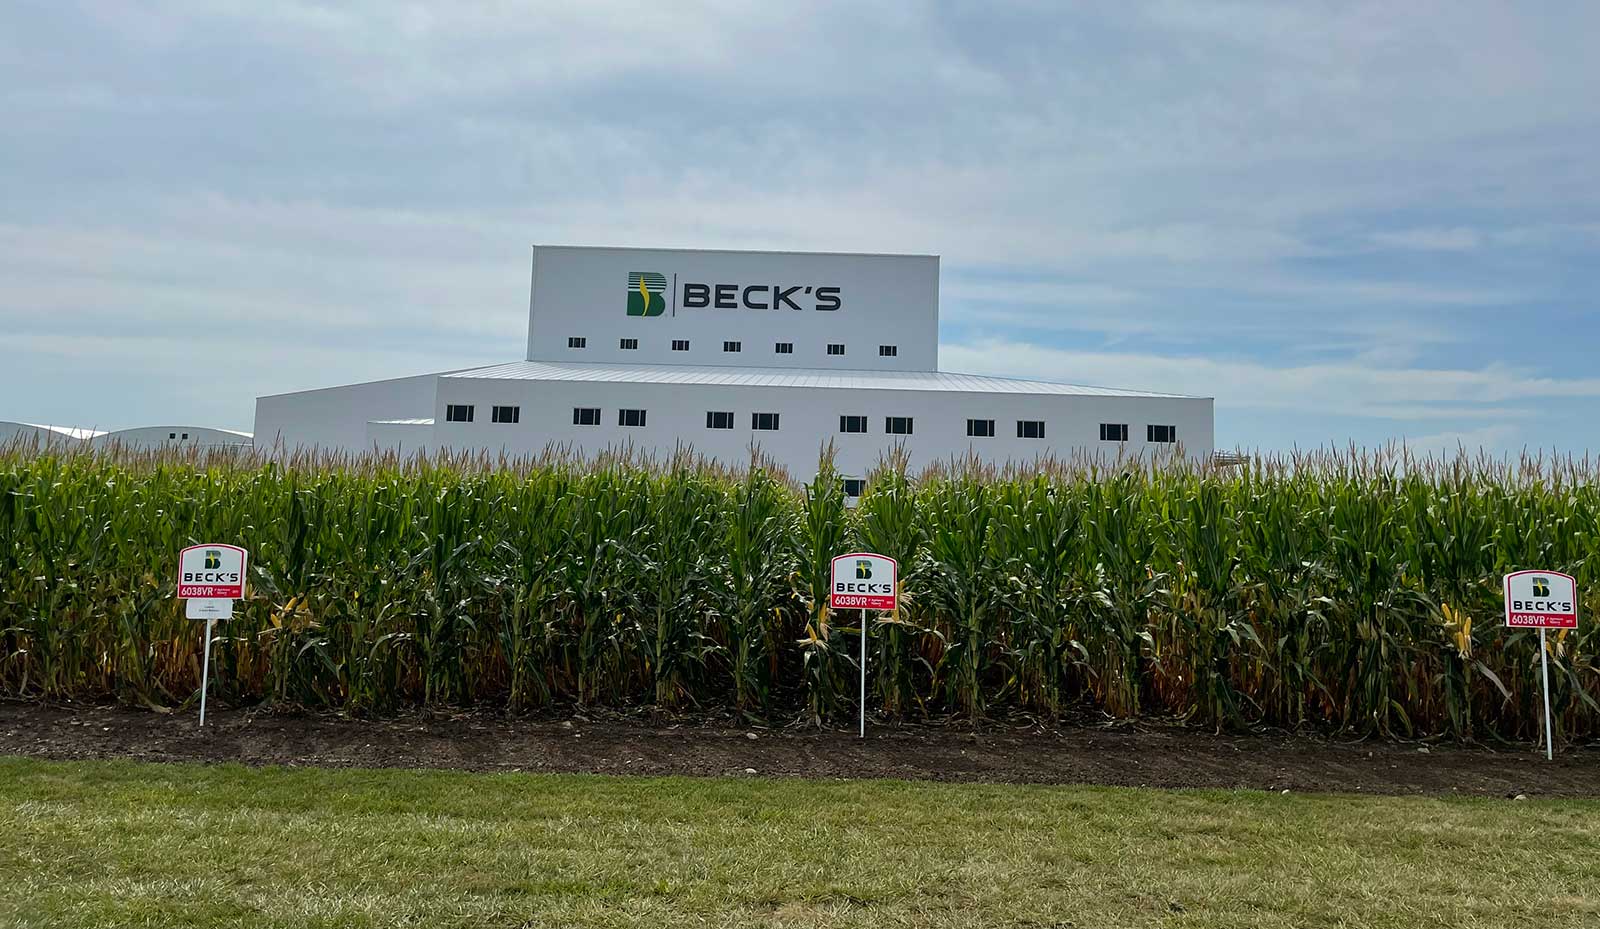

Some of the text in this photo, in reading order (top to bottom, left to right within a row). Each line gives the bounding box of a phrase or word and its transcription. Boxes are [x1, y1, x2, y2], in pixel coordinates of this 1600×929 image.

[683, 283, 842, 311] BECK'S
[184, 573, 238, 582] BECK'S
[181, 587, 213, 596] 6038VR
[836, 583, 891, 593] BECK'S
[835, 596, 867, 606] 6038VR
[1513, 601, 1571, 611] BECK'S
[1512, 615, 1545, 625] 6038VR
